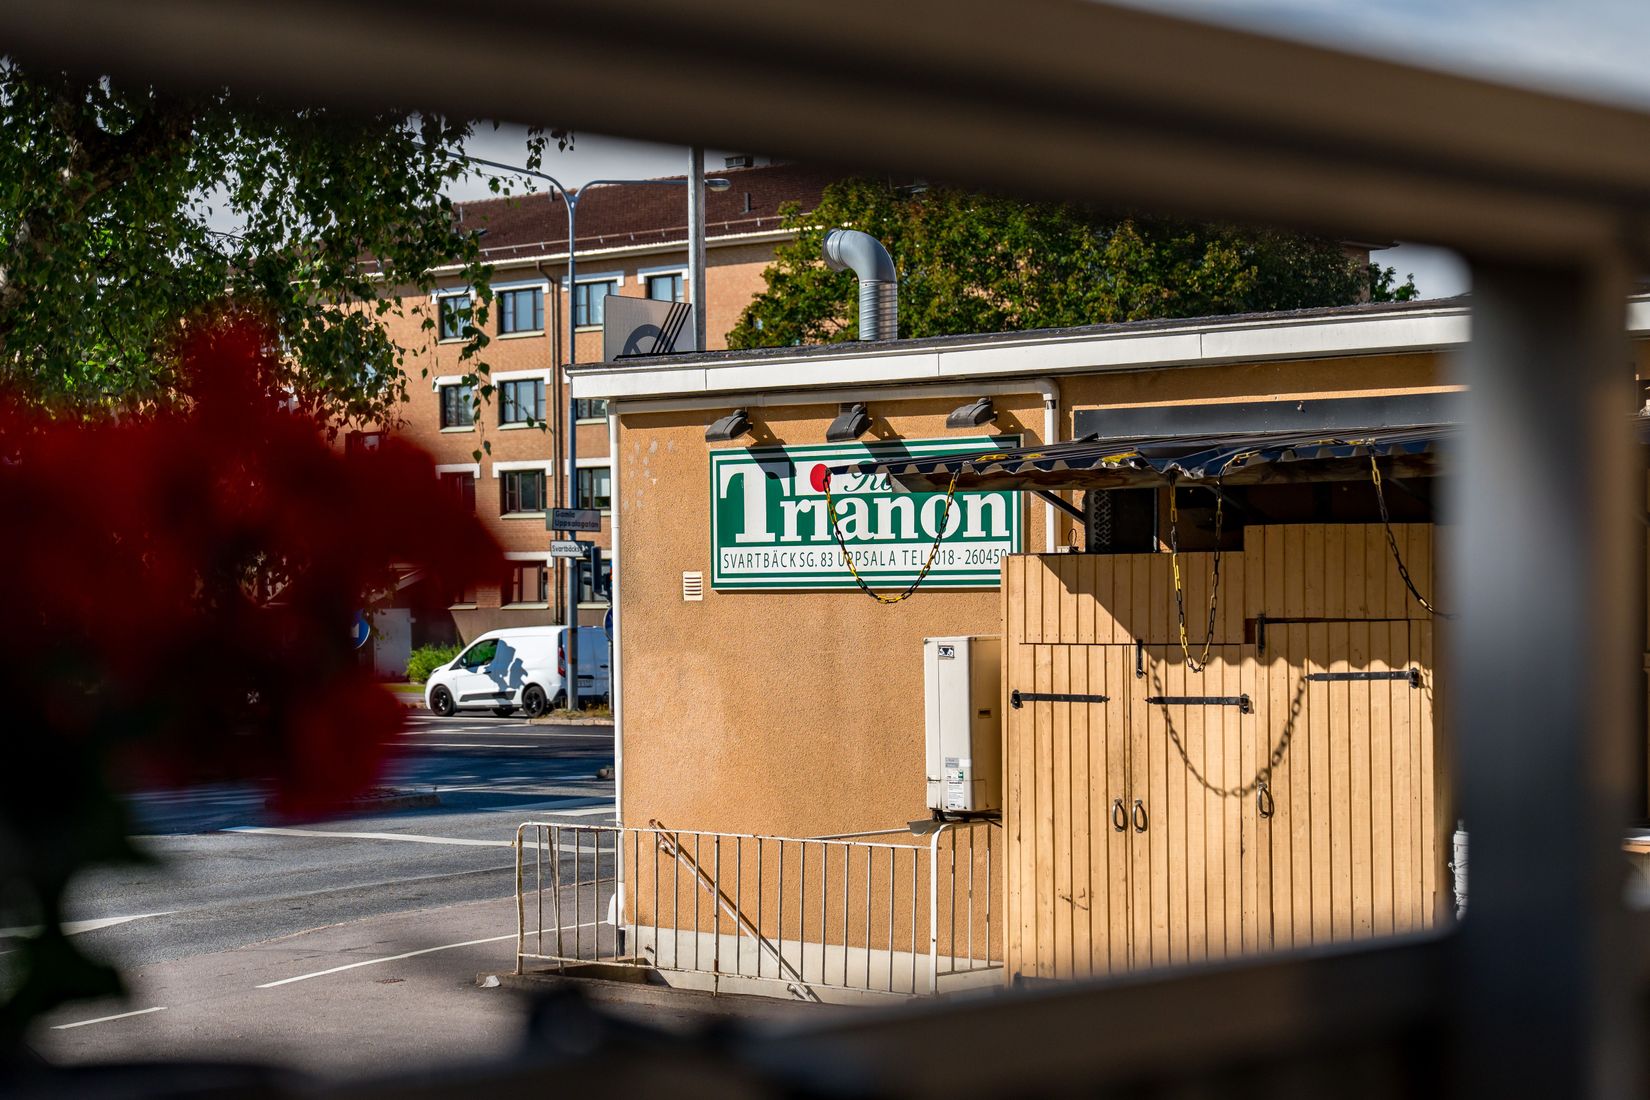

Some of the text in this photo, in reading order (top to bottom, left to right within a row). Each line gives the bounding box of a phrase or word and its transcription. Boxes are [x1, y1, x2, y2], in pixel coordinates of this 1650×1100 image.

[720, 463, 1010, 543] Trianon
[555, 510, 575, 518] Gamla
[820, 551, 833, 567] 83
[838, 550, 896, 567] UPPSALA
